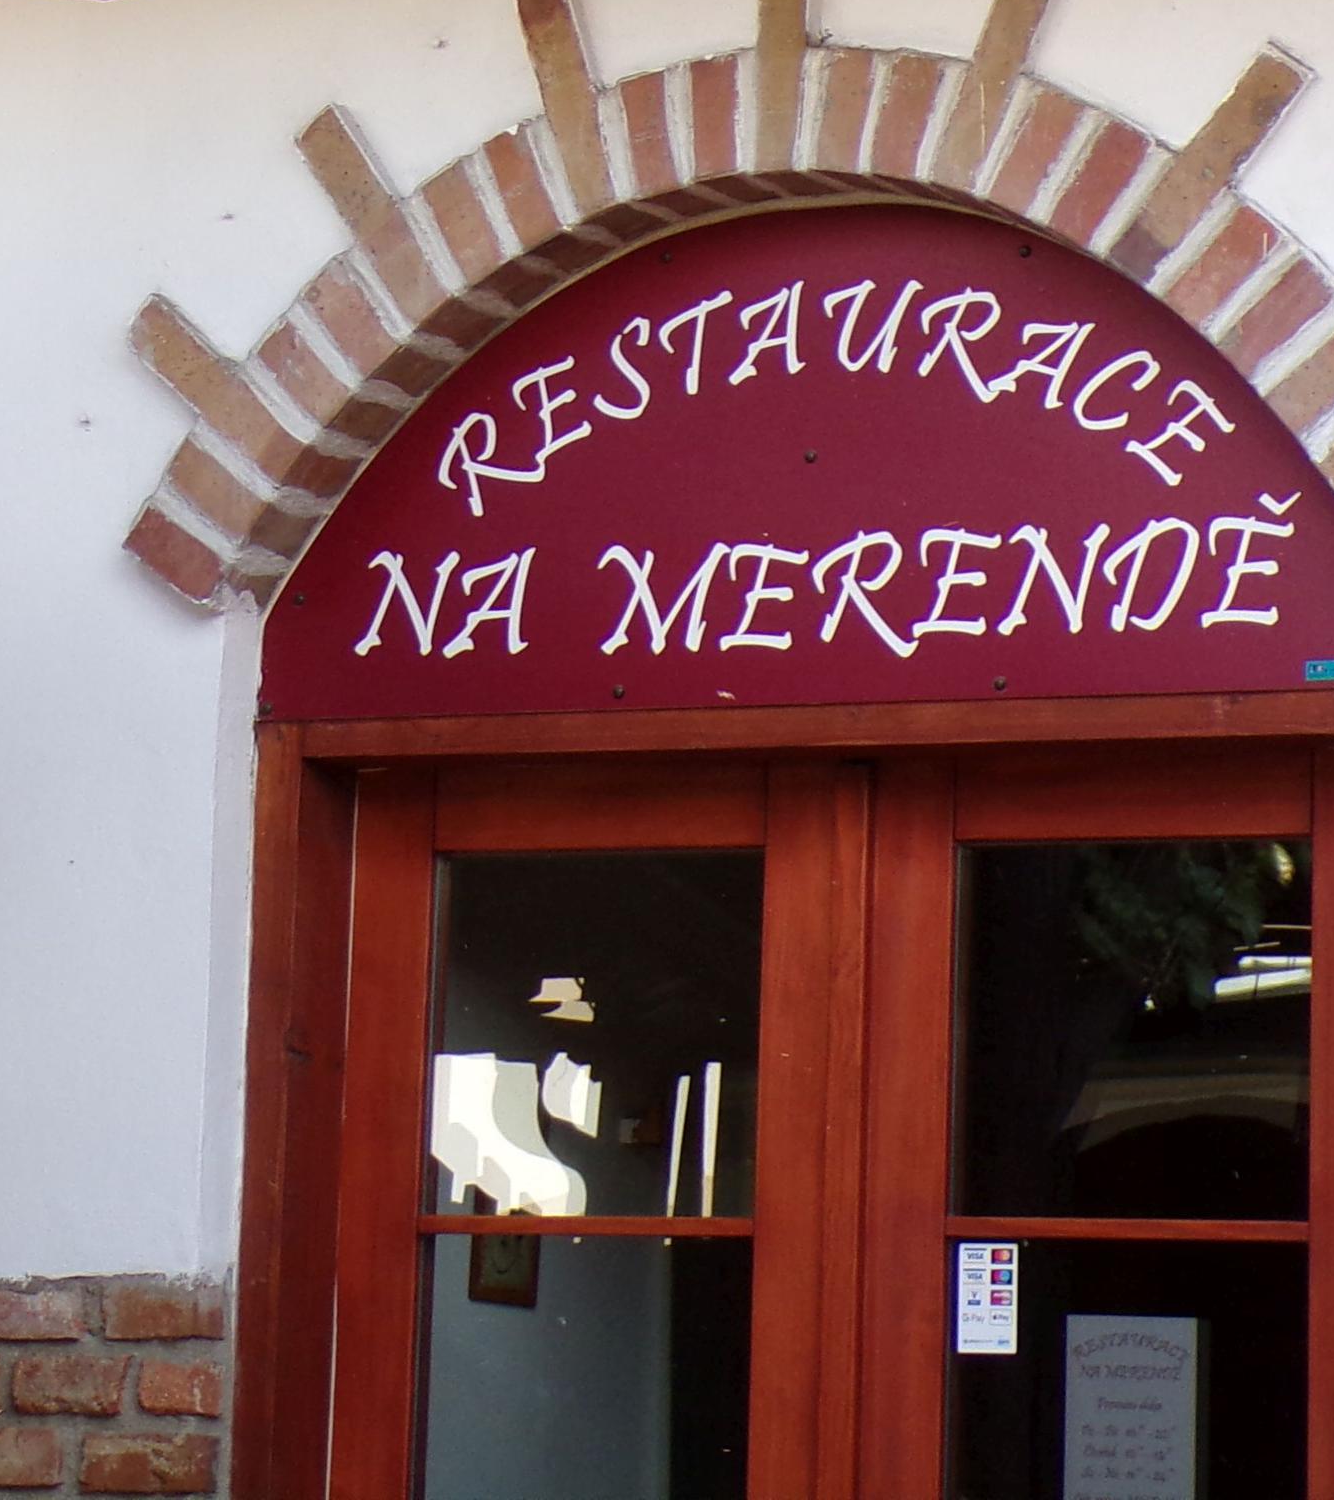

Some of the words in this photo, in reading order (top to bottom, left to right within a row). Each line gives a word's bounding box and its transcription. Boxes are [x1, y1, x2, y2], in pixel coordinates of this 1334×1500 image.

[436, 280, 1236, 517] RESTAURACE
[354, 545, 539, 658] NA
[598, 490, 1302, 659] MERENDĚ
[966, 1272, 983, 1281] VISA
[967, 1252, 984, 1260] VISA
